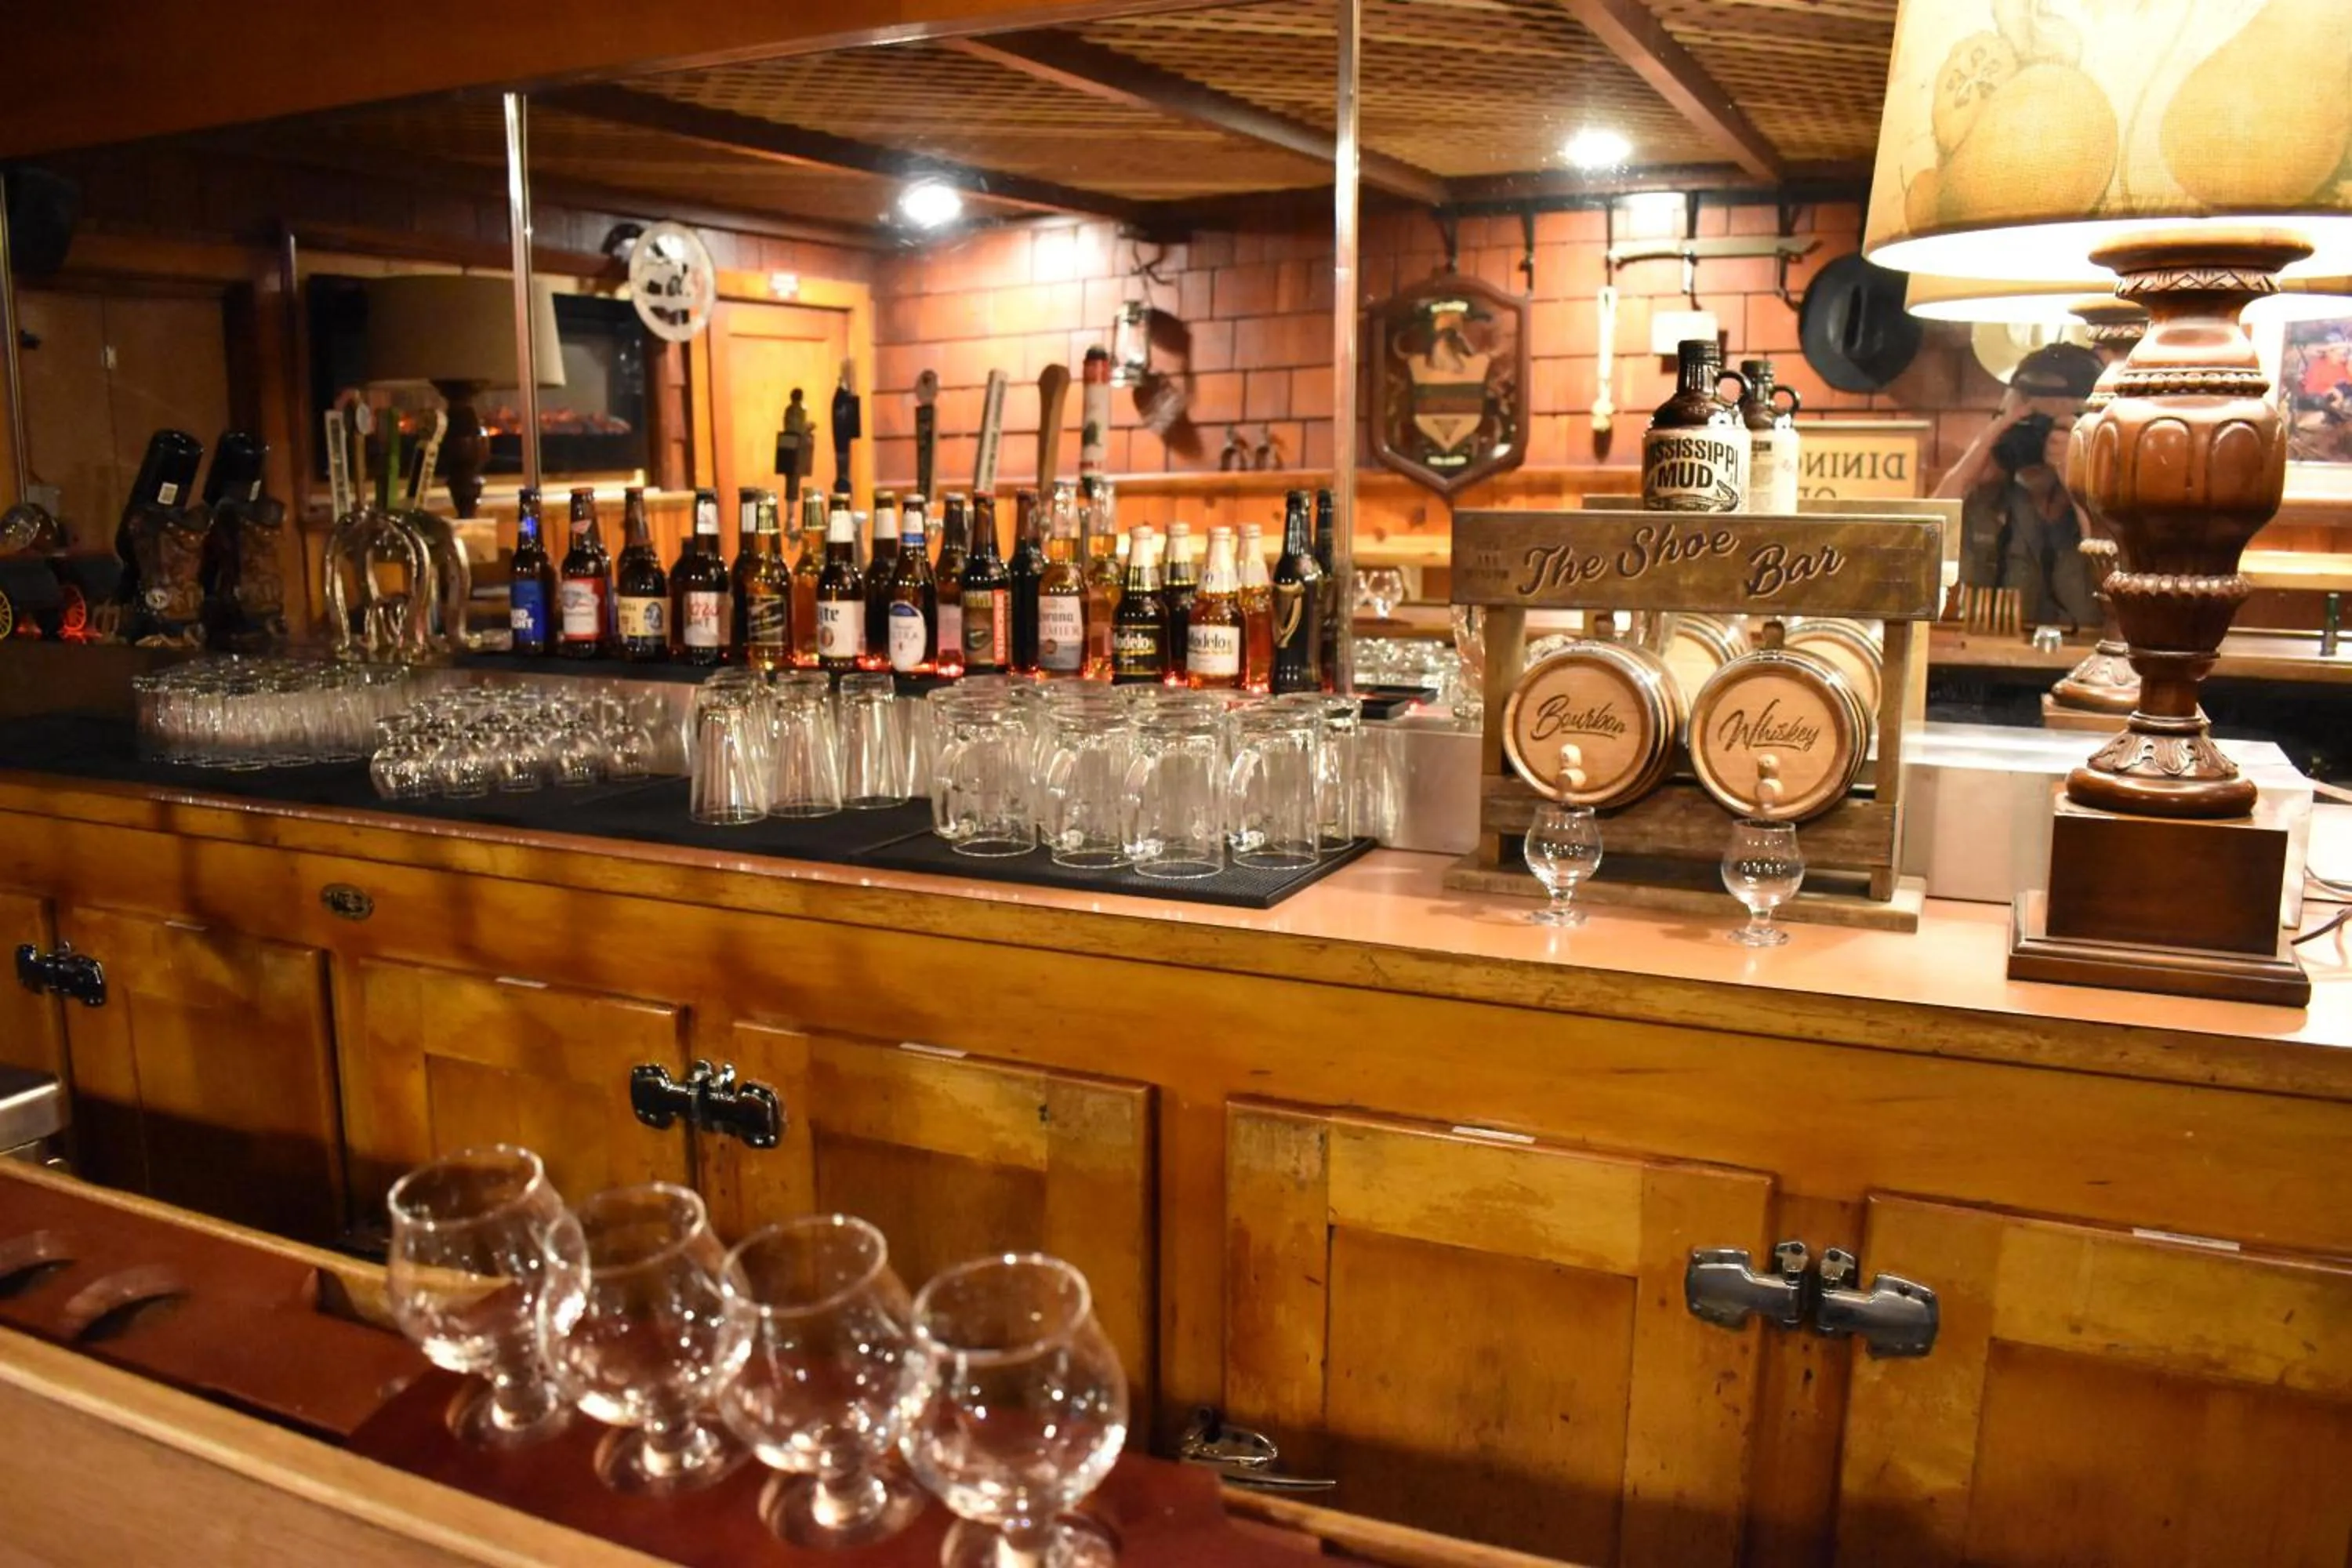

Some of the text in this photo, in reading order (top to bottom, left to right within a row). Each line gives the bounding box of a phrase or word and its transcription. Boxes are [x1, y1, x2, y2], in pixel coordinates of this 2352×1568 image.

[1650, 438, 1739, 486] SSISSIPPI
[1657, 462, 1713, 488] MUD
[1517, 524, 1847, 598] The Shoe Bar
[818, 607, 840, 622] ite
[1040, 612, 1074, 623] orona
[1530, 694, 1628, 742] Bourbon
[1718, 699, 1821, 753] Whiskey
